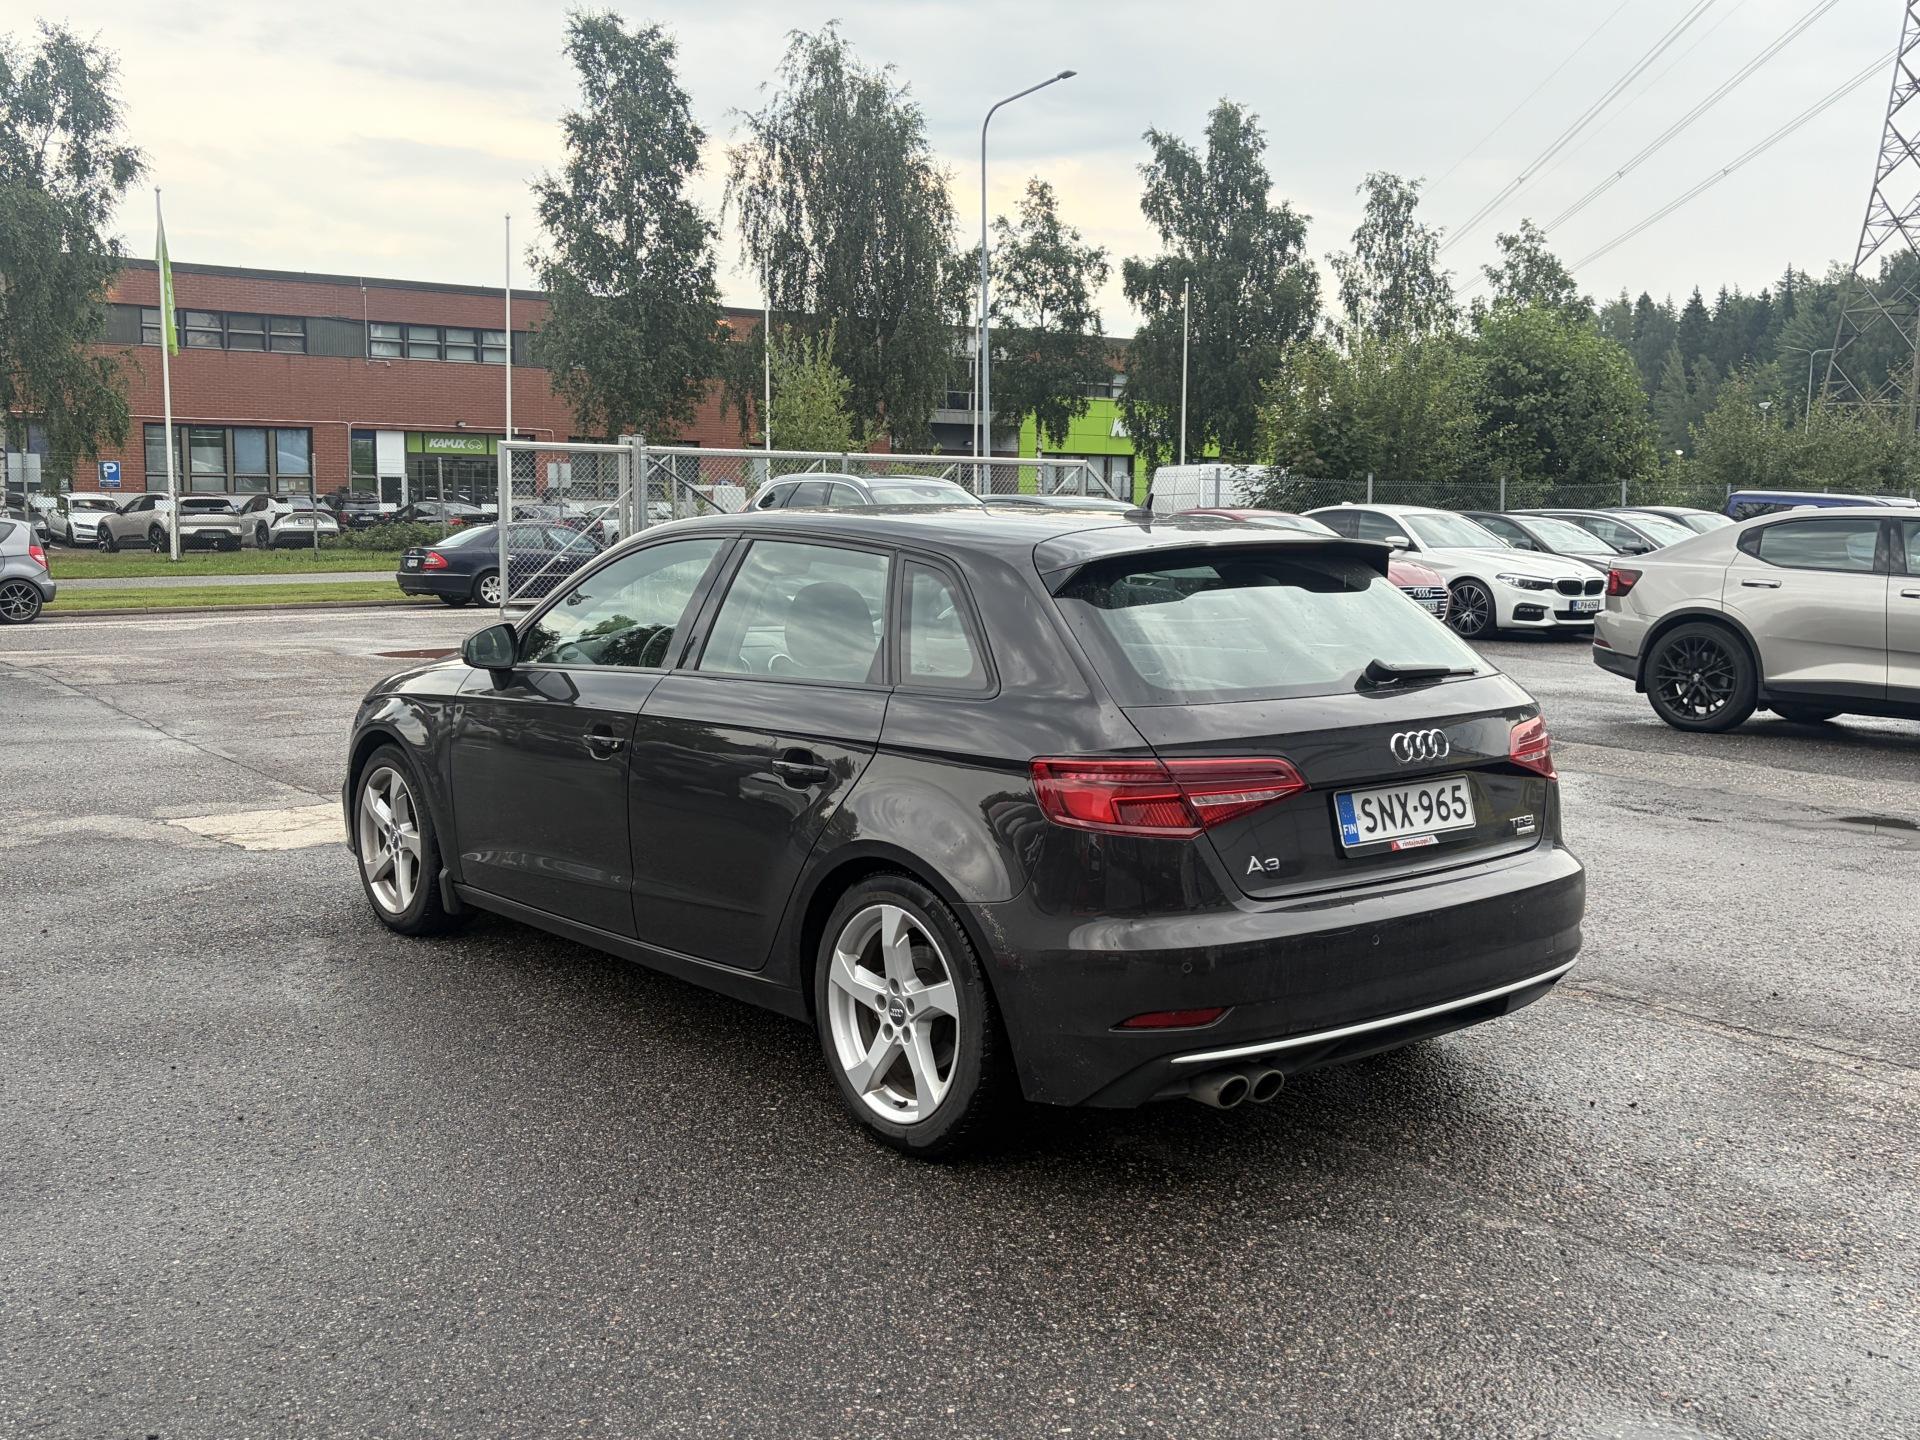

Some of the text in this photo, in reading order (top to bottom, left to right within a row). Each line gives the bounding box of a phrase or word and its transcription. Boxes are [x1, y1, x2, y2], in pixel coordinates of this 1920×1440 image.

[429, 438, 466, 449] KAMUX
[103, 463, 117, 478] P
[1360, 784, 1467, 833] SNX-965
[1509, 814, 1534, 828] TFSI
[1343, 824, 1358, 835] FIN
[1246, 855, 1280, 875] A3
